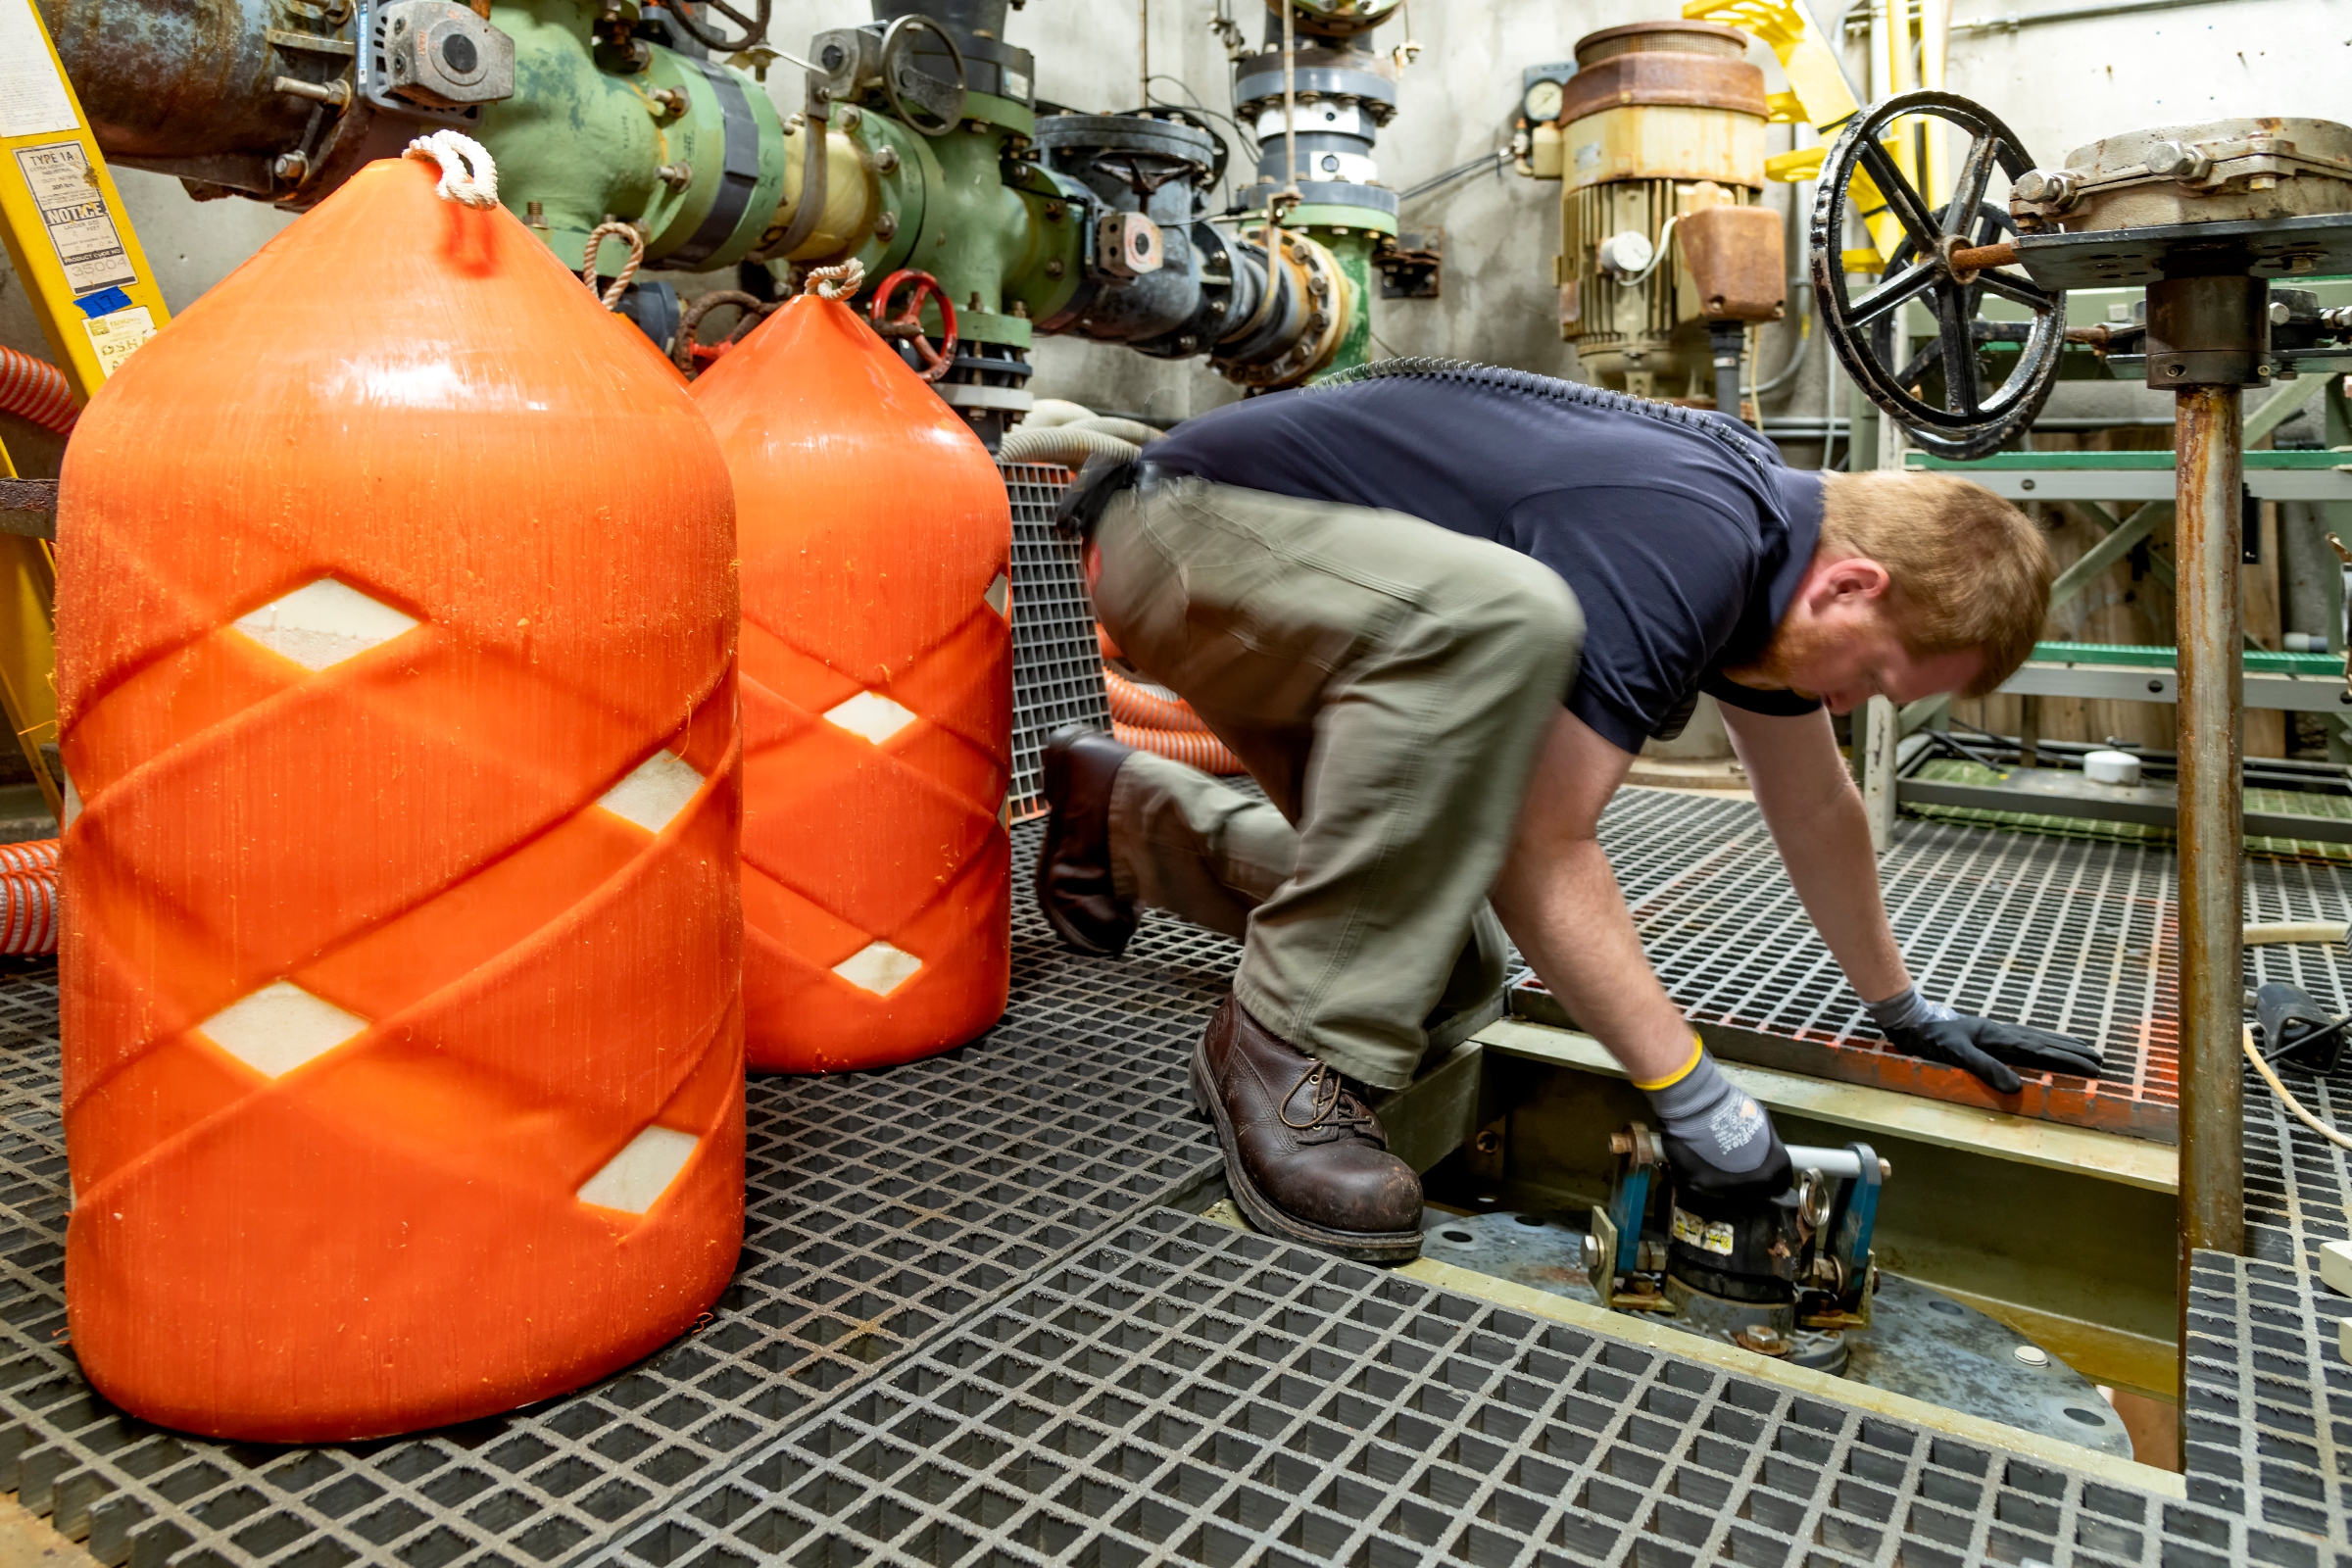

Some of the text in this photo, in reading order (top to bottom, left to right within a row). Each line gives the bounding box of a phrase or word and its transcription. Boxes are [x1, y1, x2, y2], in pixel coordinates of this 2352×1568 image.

[359, 15, 368, 67] HAYWARD
[29, 152, 74, 166] TYPE 1A
[47, 203, 104, 224] NOTICE
[64, 221, 86, 230] LADDER
[64, 254, 93, 264] PRODUCT
[72, 257, 127, 277] 35004
[93, 295, 117, 312] 17
